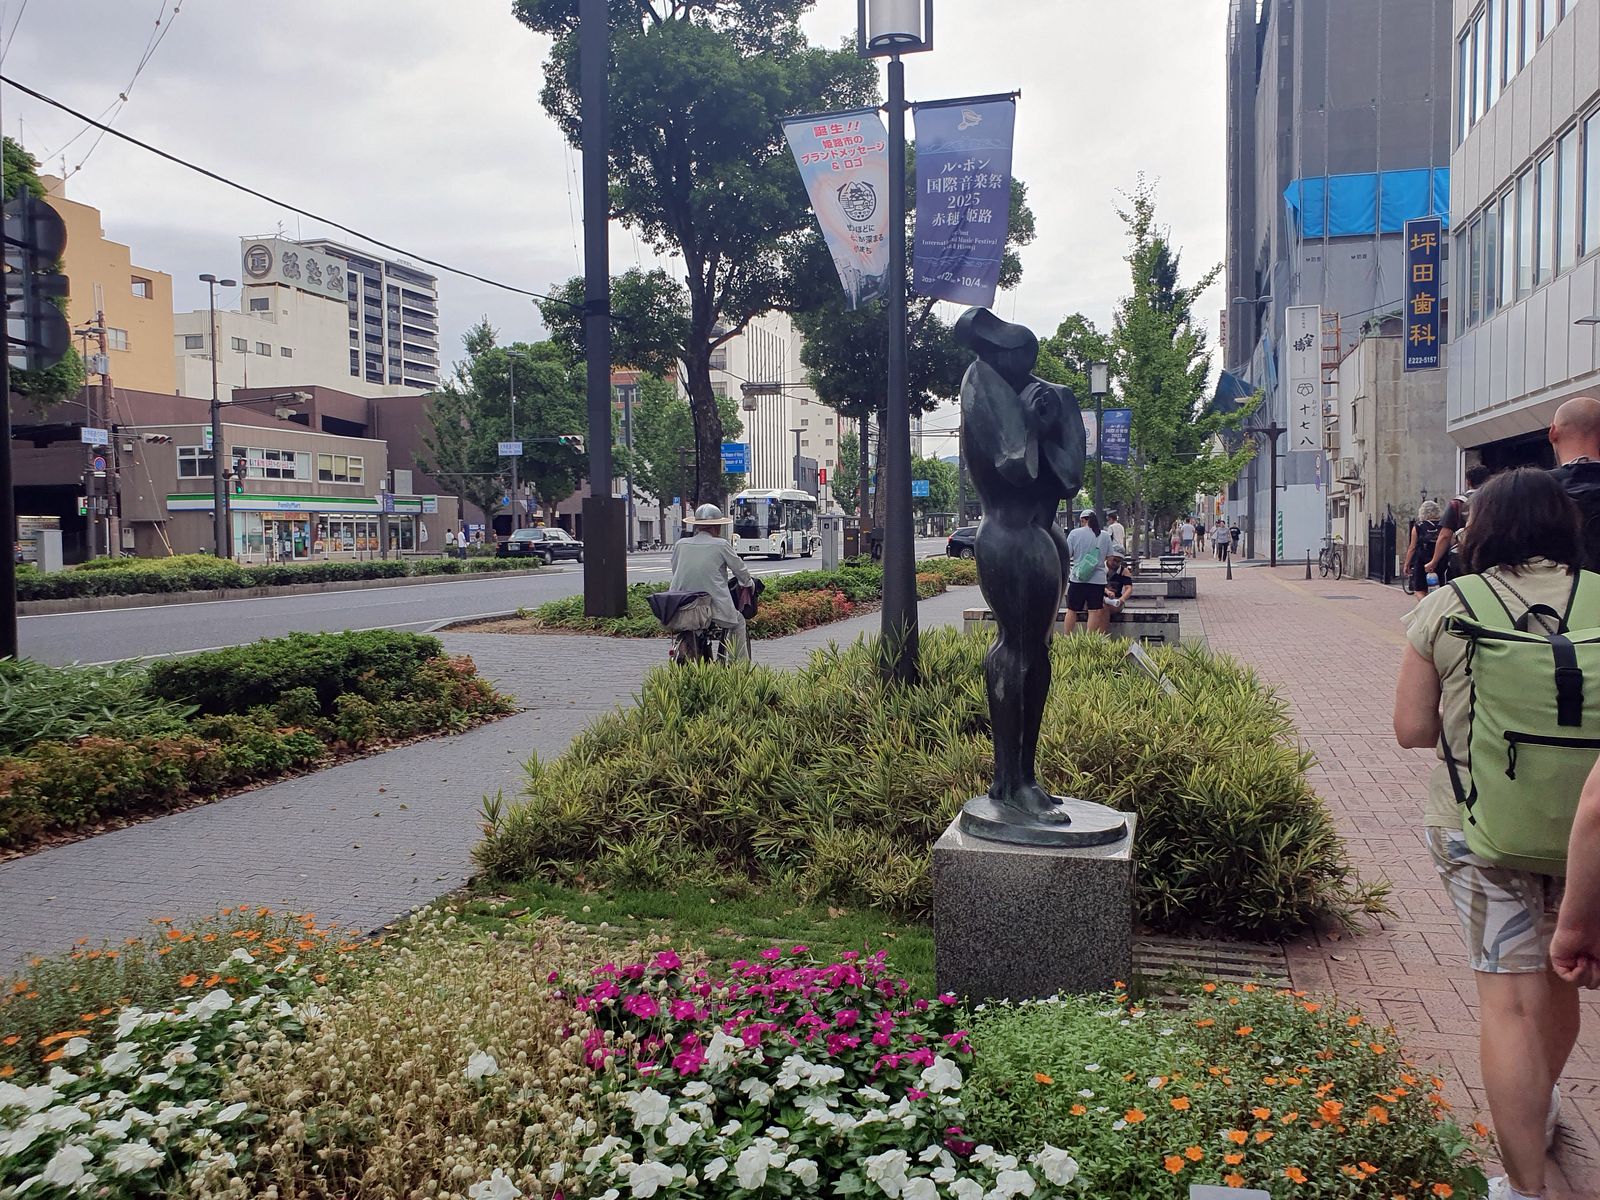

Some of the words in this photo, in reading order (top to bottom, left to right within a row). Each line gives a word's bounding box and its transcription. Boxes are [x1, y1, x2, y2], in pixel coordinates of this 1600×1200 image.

[822, 135, 863, 149] 姫路市の
[844, 157, 863, 169] ロゴ
[940, 157, 991, 174] ル・ポン
[925, 173, 1002, 194] 国際音楽祭
[947, 192, 981, 209] 2025
[961, 277, 981, 287] 10/4
[1409, 233, 1437, 346] 坪田歯科
[1299, 404, 1314, 446] 十七八
